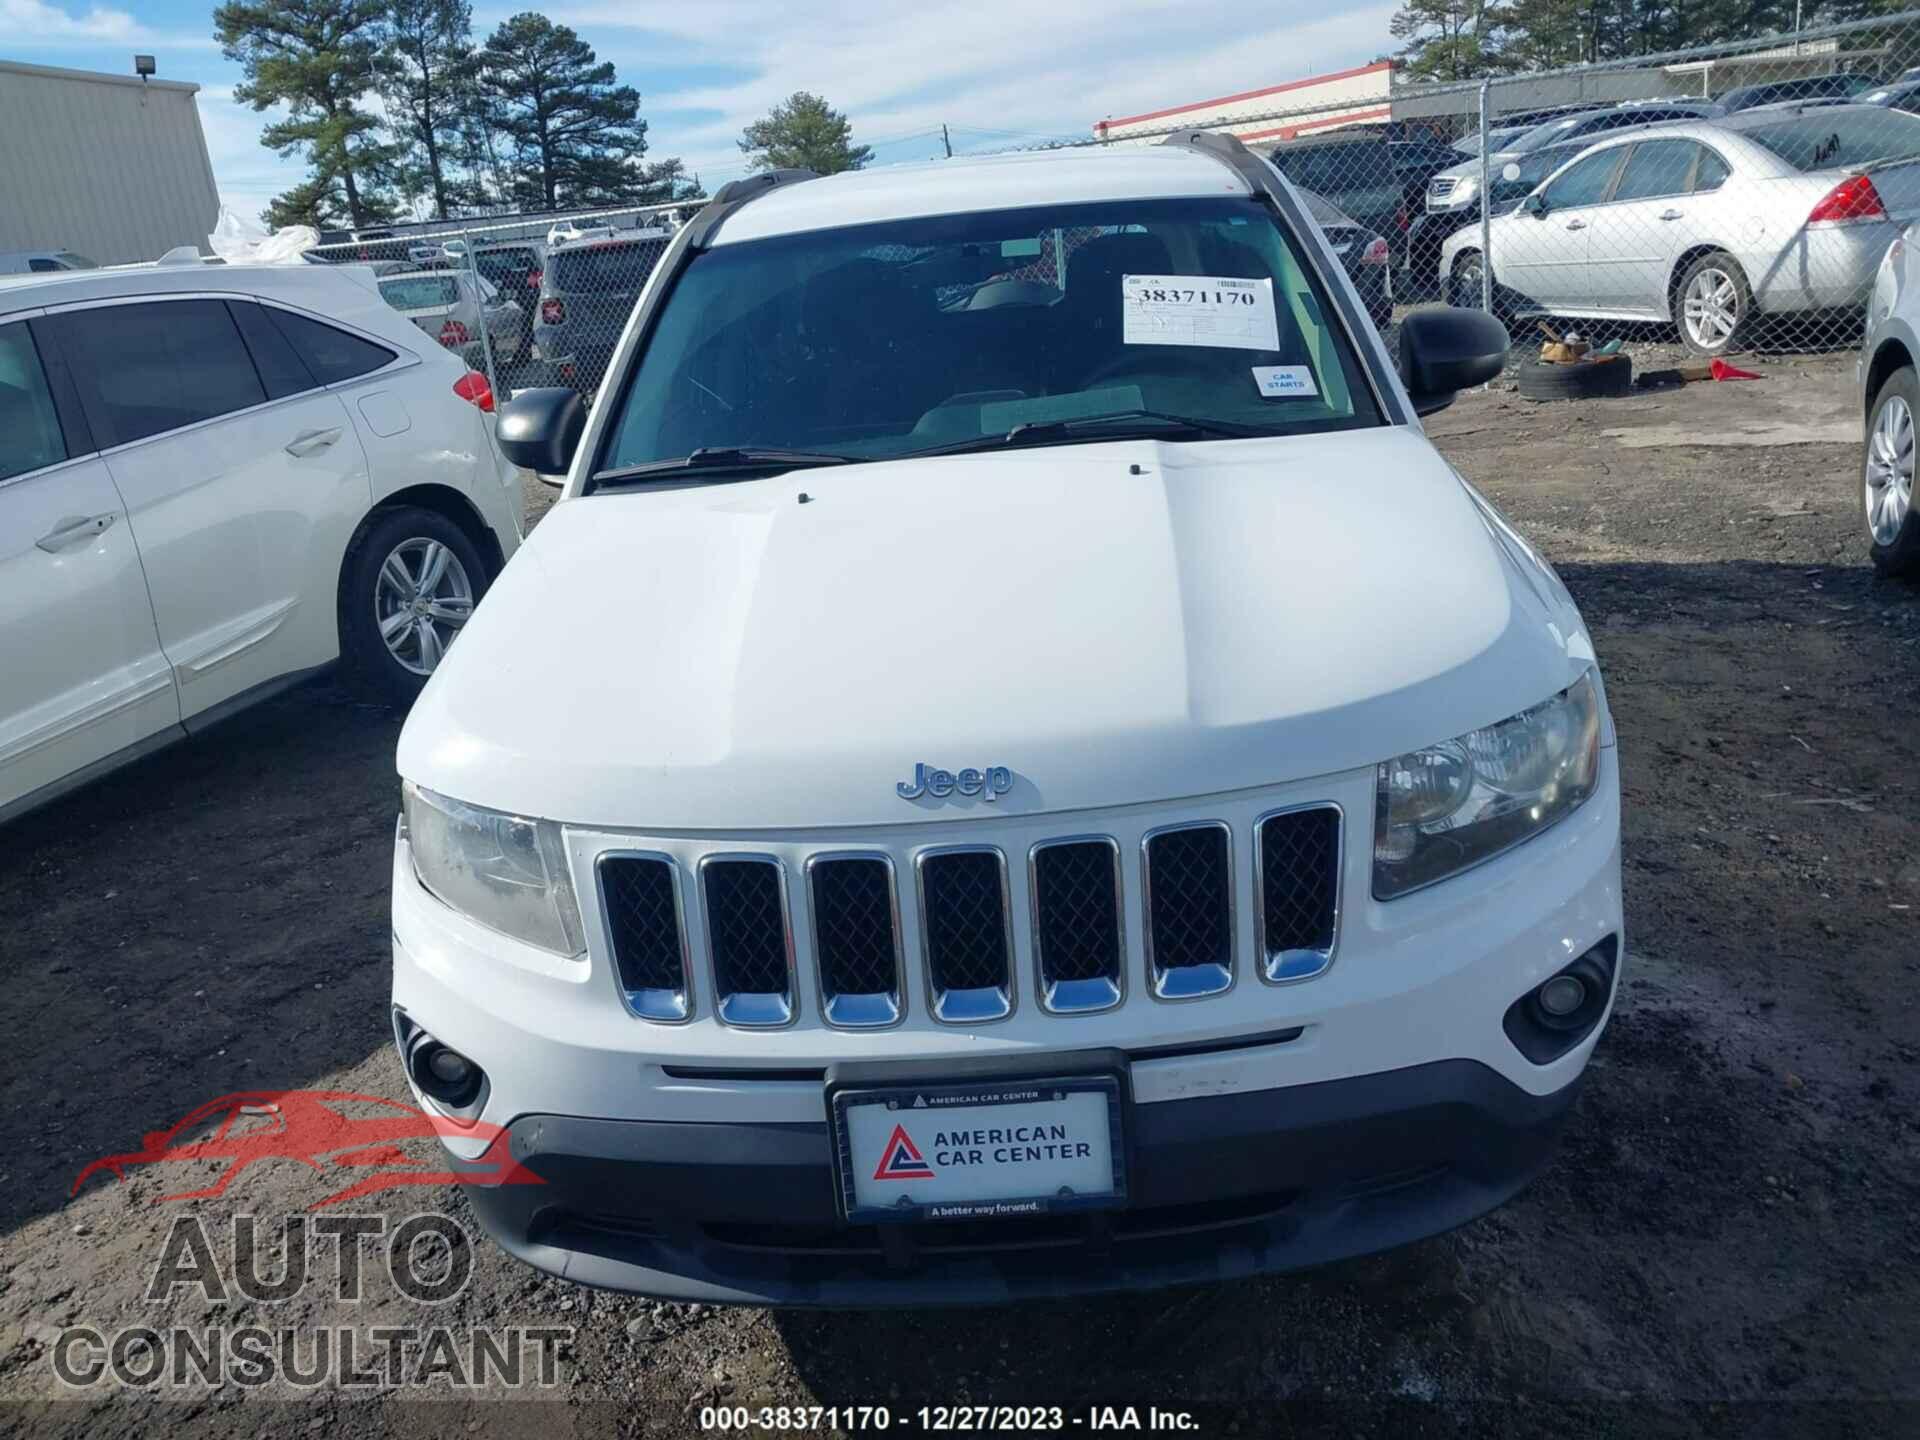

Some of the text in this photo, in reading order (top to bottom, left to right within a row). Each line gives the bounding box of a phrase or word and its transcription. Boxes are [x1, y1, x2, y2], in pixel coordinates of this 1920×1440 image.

[1139, 288, 1255, 305] 38371170
[896, 762, 1014, 801] Jeep
[930, 1091, 1039, 1105] AMERICAN CAR CENTER
[934, 1125, 1066, 1147] AMERICAN
[936, 1143, 1091, 1166] CAR CENTER
[932, 1202, 1040, 1216] A better way forward.
